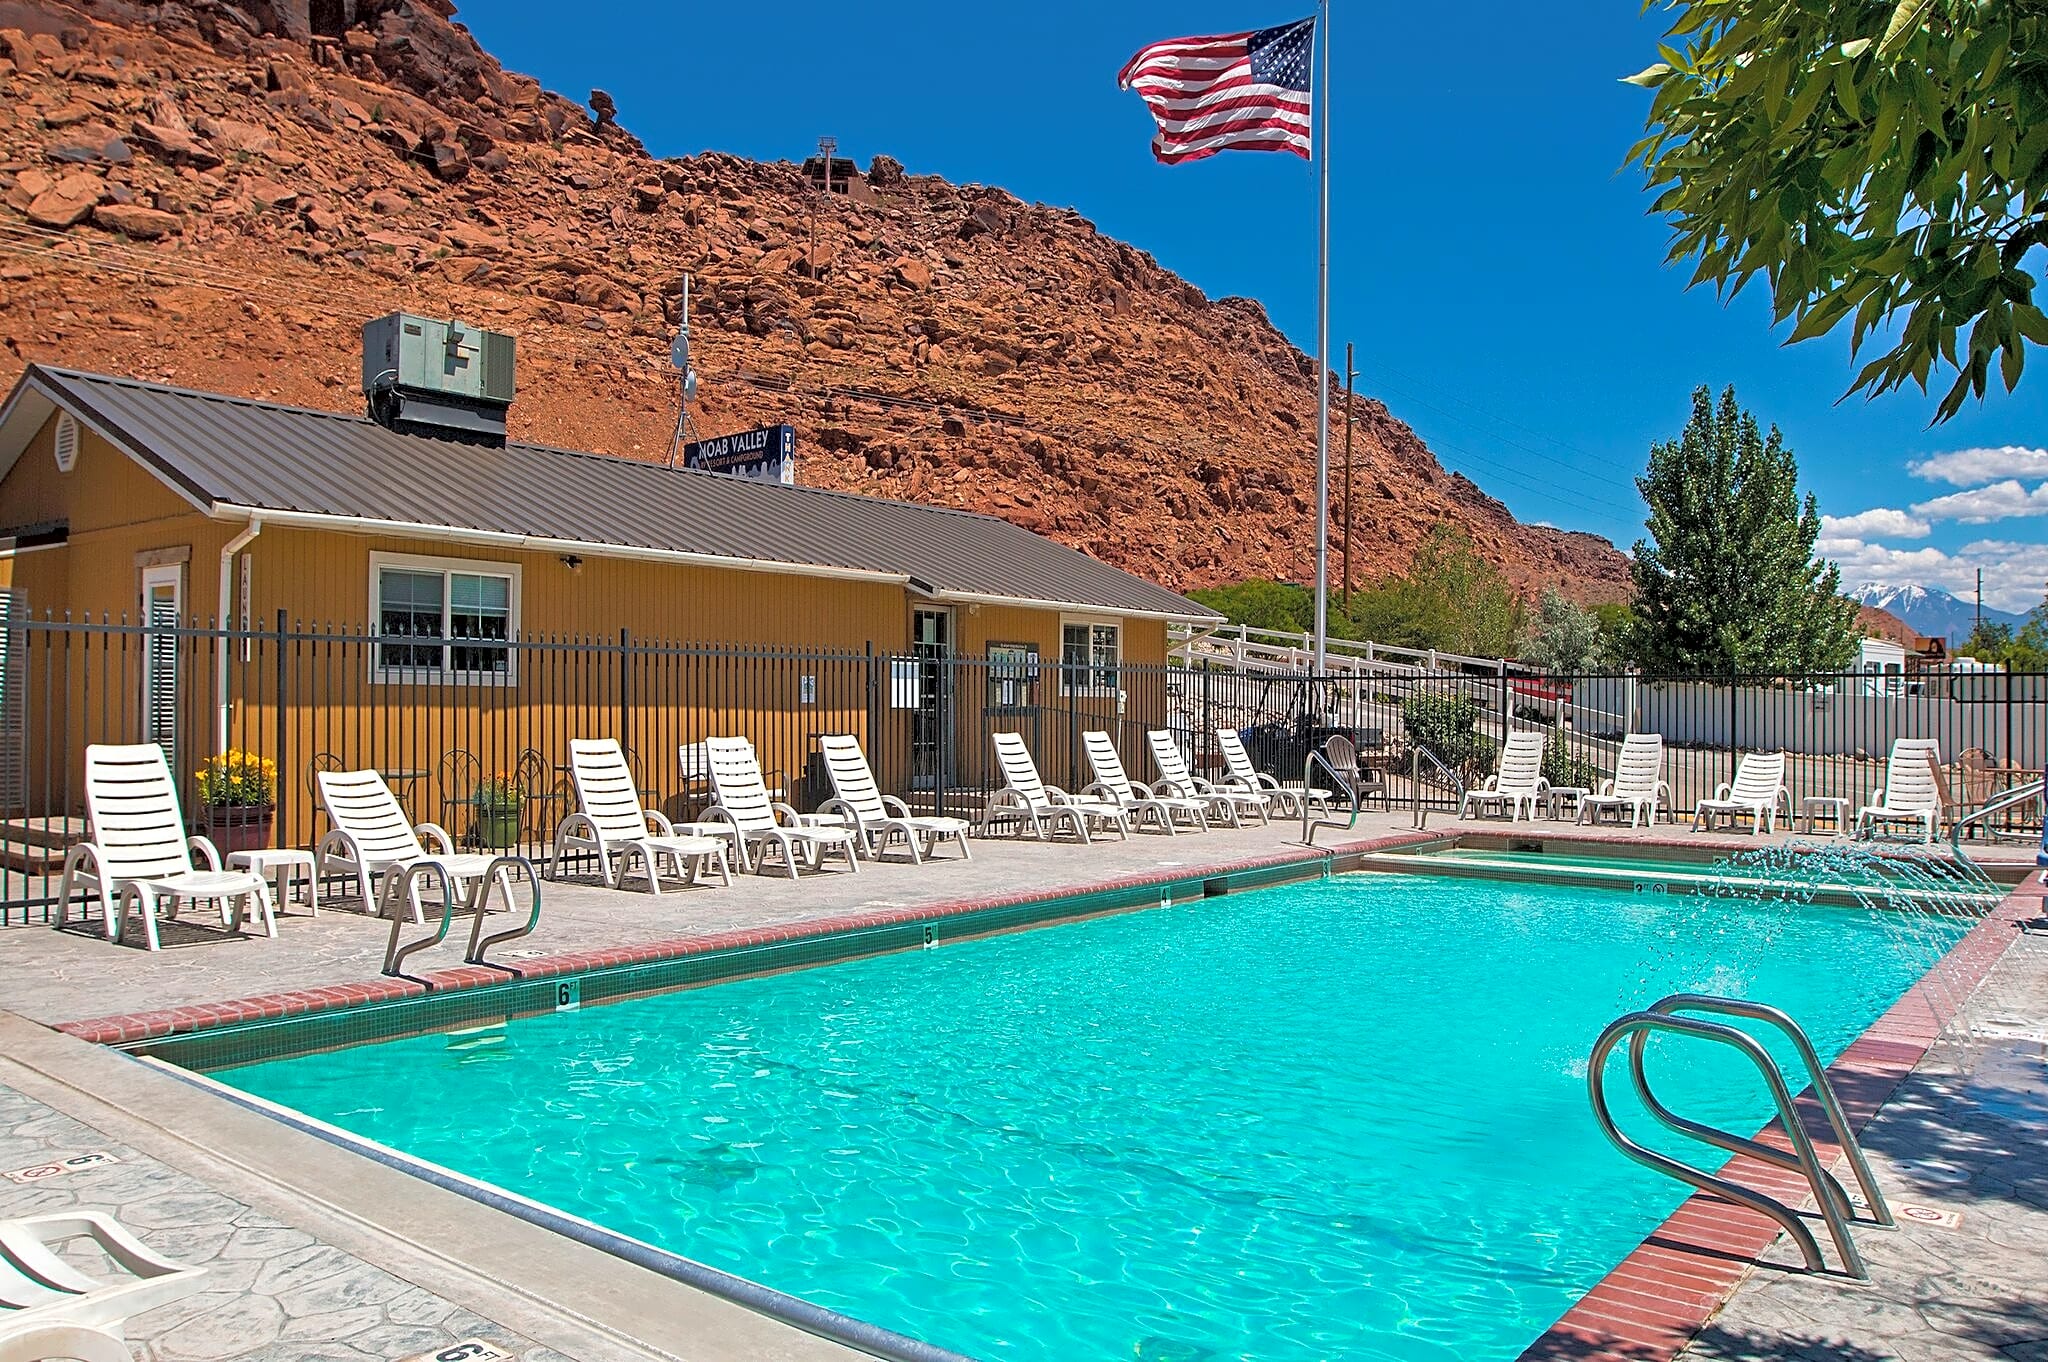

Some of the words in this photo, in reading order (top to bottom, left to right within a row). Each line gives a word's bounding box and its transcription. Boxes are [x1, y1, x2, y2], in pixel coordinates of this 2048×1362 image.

[731, 430, 769, 452] VALLEY
[1161, 887, 1167, 903] 4
[925, 926, 932, 944] 5
[559, 983, 570, 1005] 6
[66, 1154, 104, 1165] 6
[436, 1343, 484, 1362] 6
